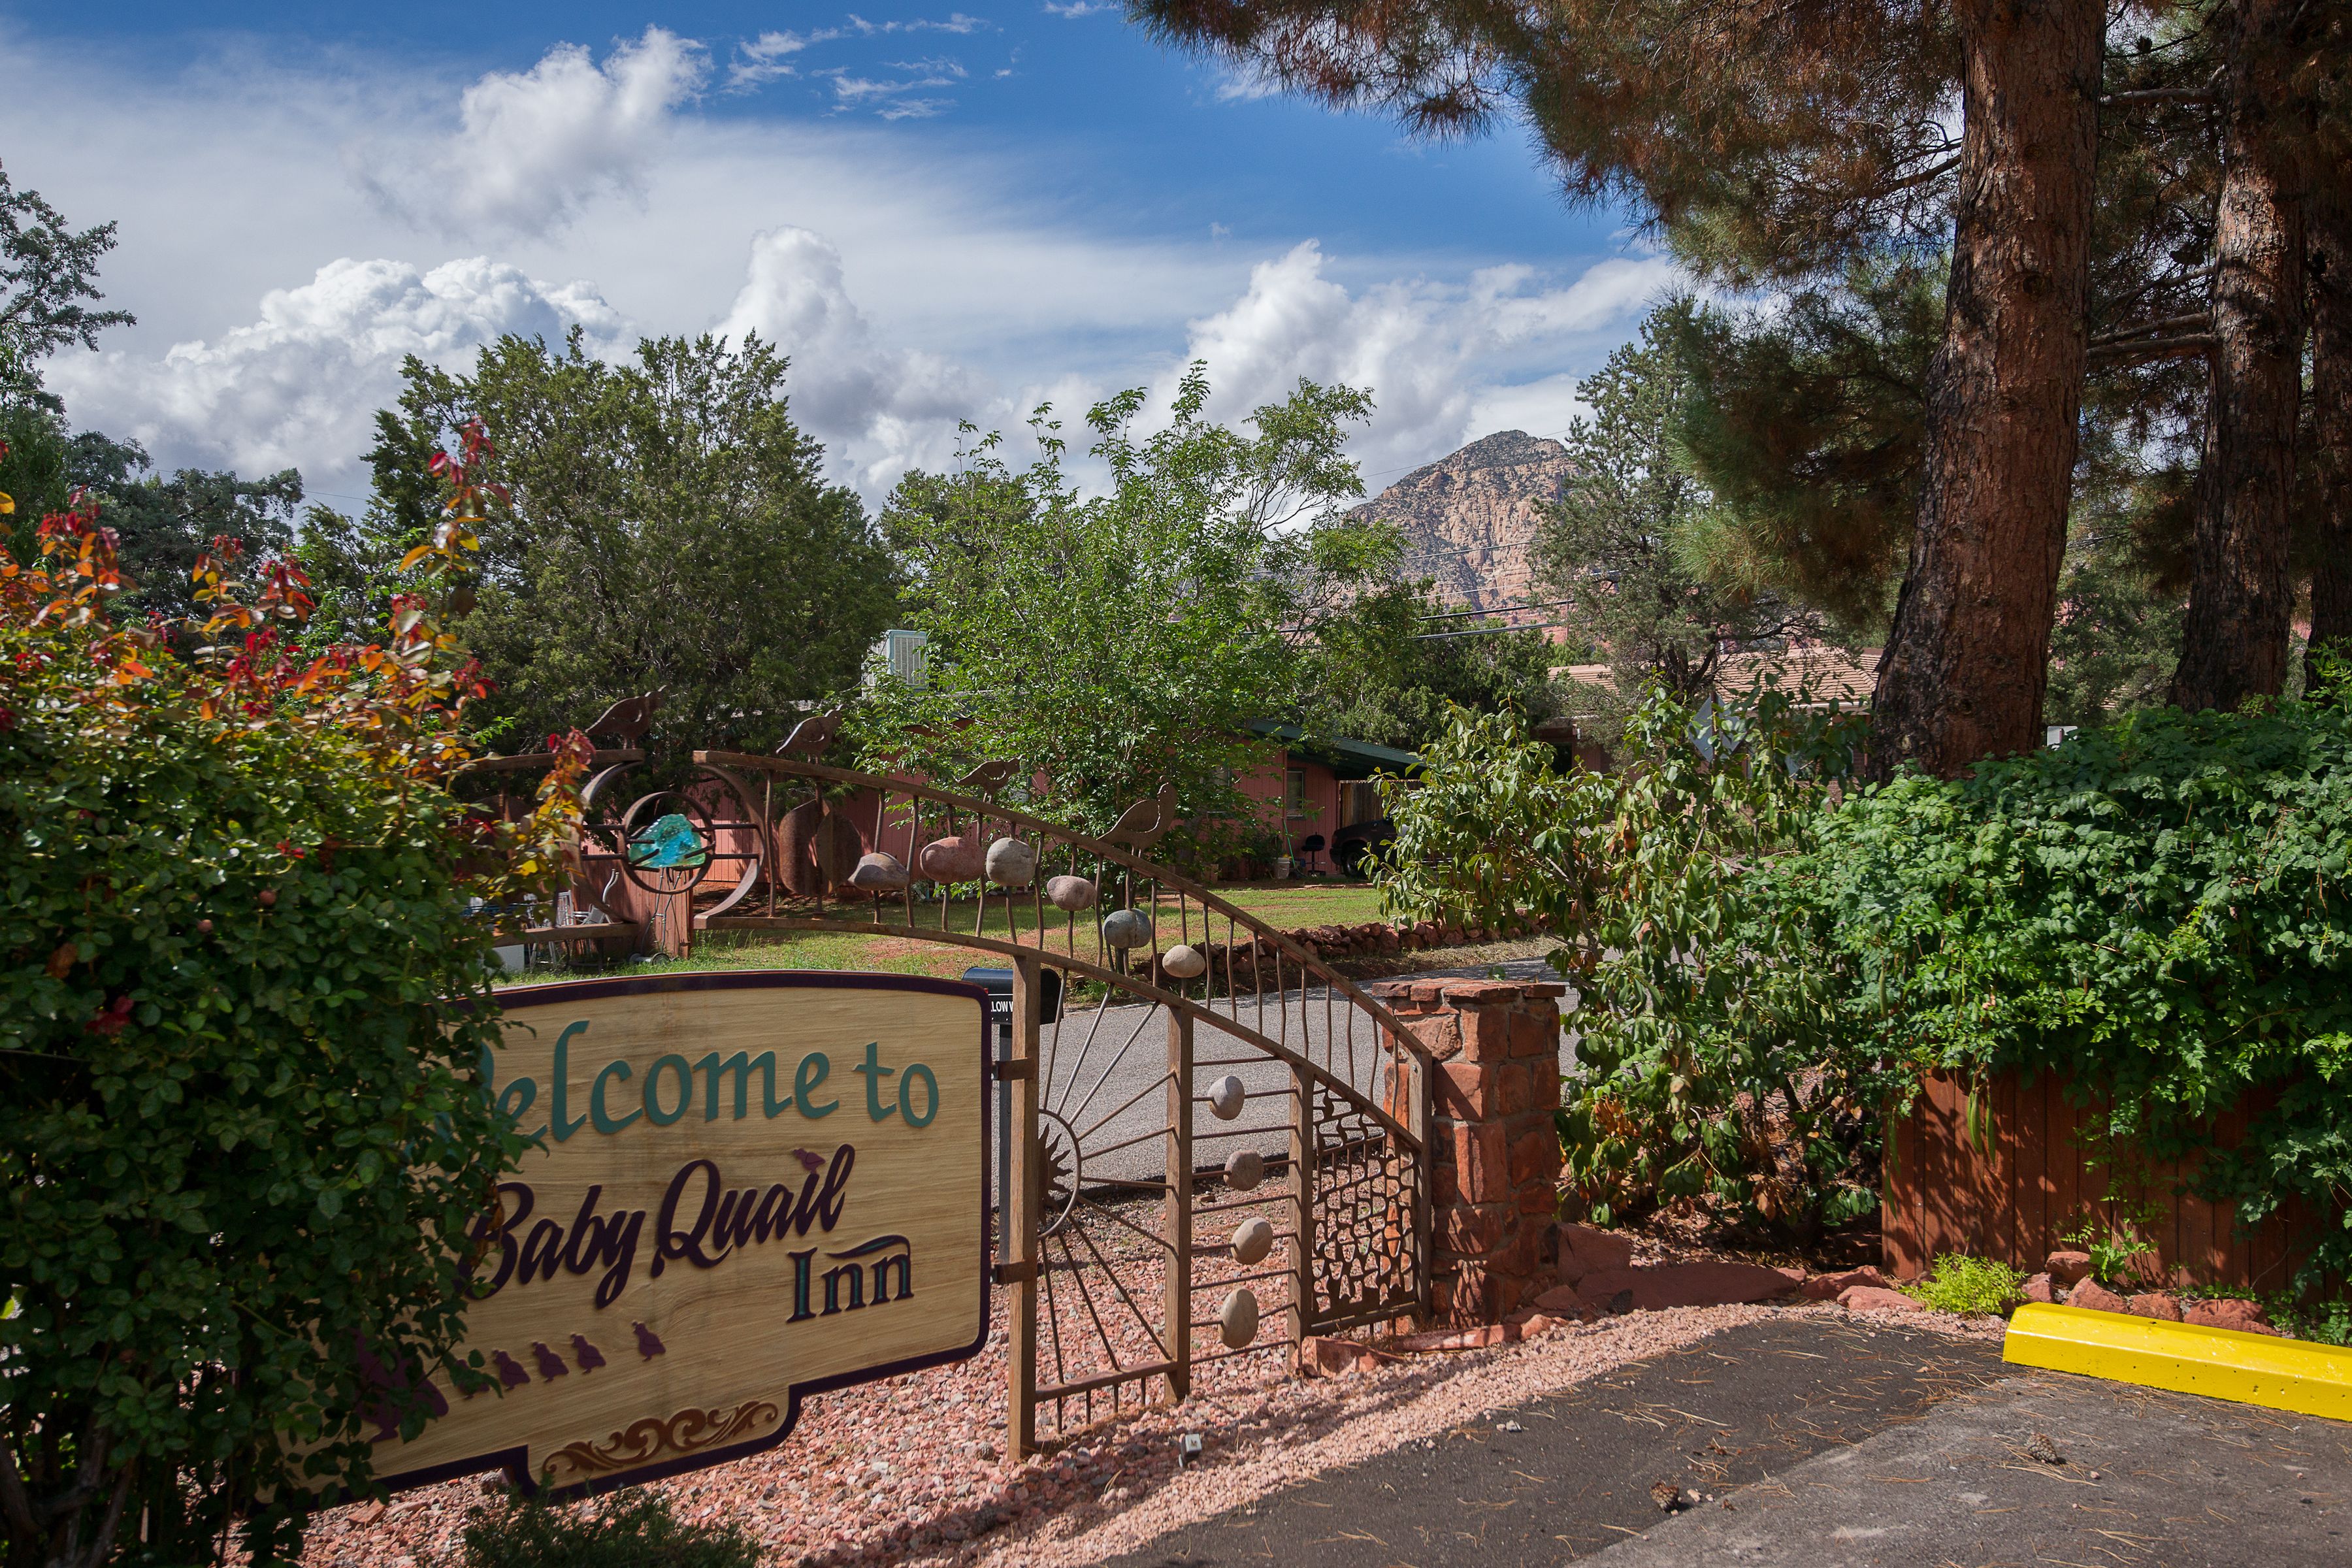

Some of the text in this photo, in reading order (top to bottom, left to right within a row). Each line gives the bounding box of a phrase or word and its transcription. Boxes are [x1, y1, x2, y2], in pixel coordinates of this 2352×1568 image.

[990, 1001, 1008, 1012] LOW
[853, 1041, 939, 1128] to
[454, 1143, 856, 1309] Baby Quail
[786, 1235, 914, 1323] Inn
